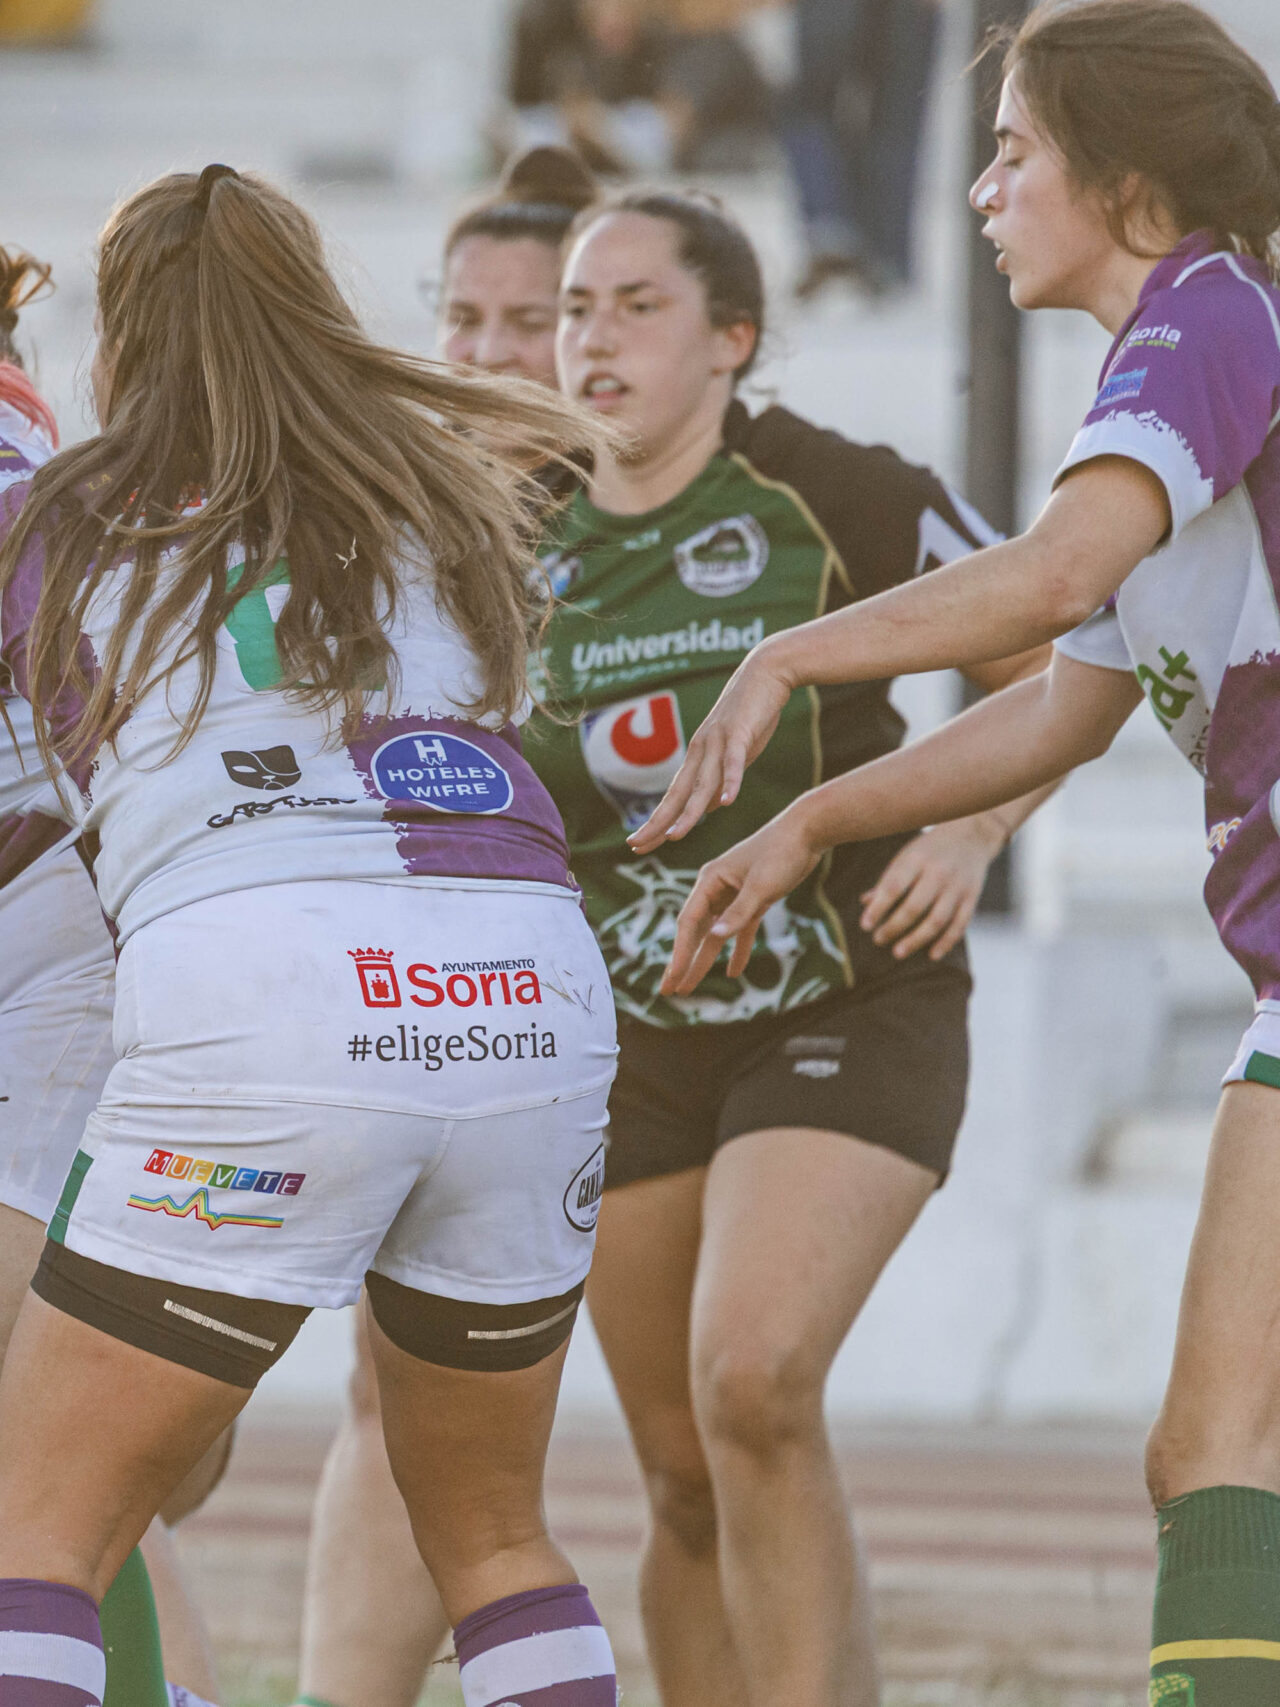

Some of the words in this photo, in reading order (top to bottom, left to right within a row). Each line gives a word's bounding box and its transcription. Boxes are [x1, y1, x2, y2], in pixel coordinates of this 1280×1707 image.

[572, 617, 764, 672] Universidad
[387, 766, 497, 782] HOTELES
[407, 783, 490, 798] WIFRE
[441, 958, 536, 974] AYUNTAMIENTO
[406, 963, 543, 1008] Soria
[347, 1022, 558, 1072] #eligeSoria
